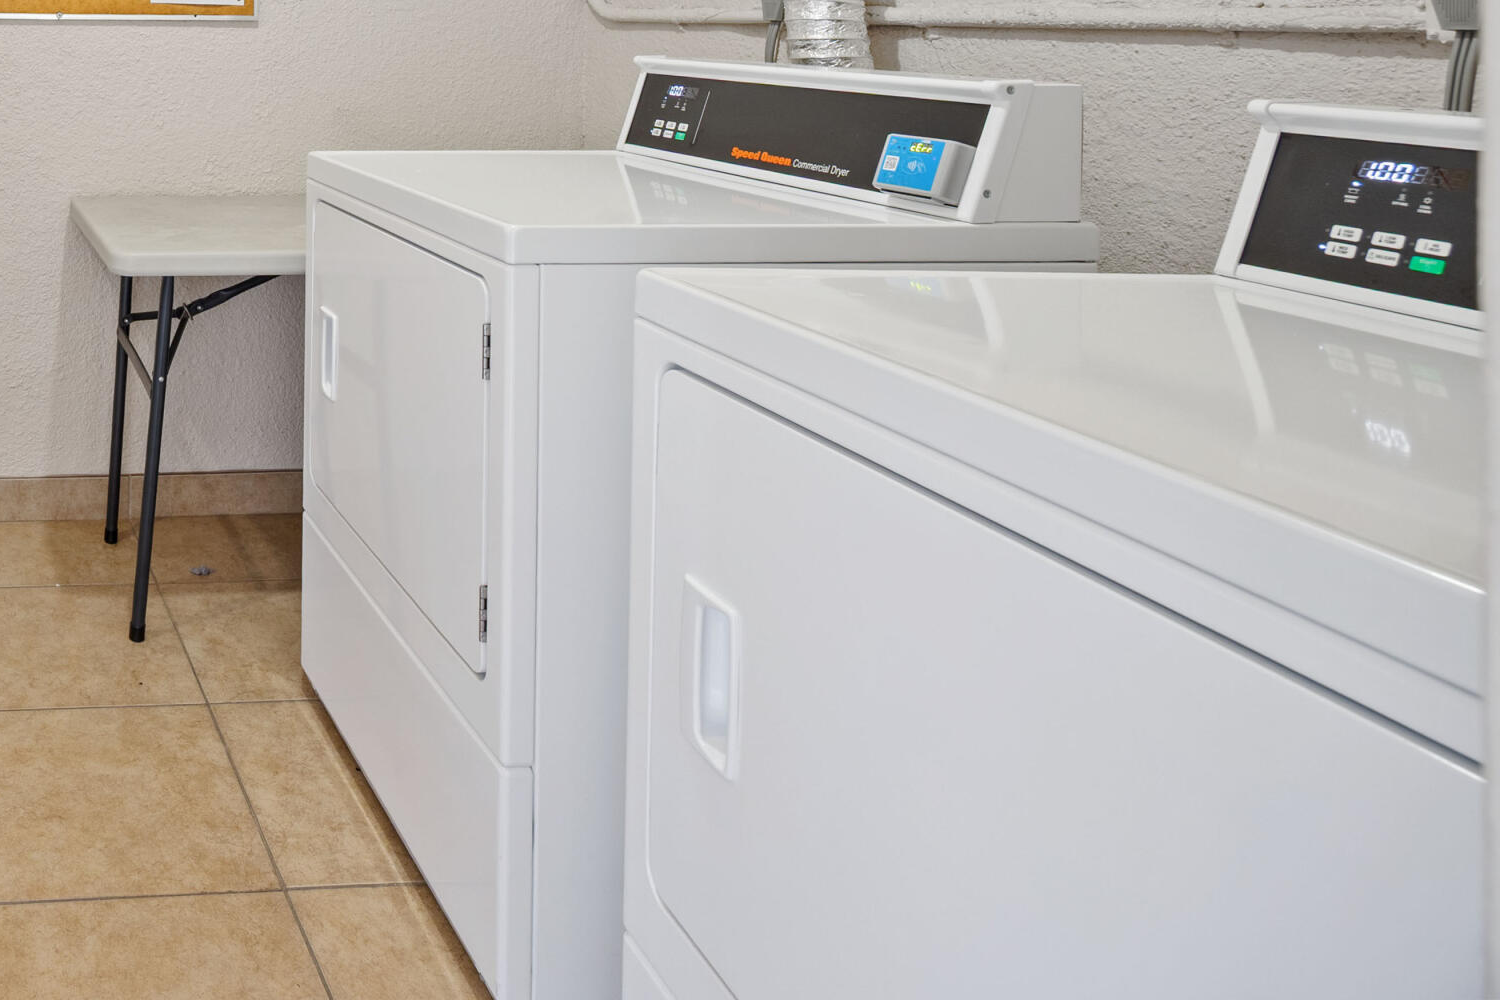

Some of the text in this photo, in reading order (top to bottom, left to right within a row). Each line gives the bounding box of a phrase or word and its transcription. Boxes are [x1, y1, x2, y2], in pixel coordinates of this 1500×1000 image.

[731, 146, 850, 178] Speed Queen Commercial Dryer
